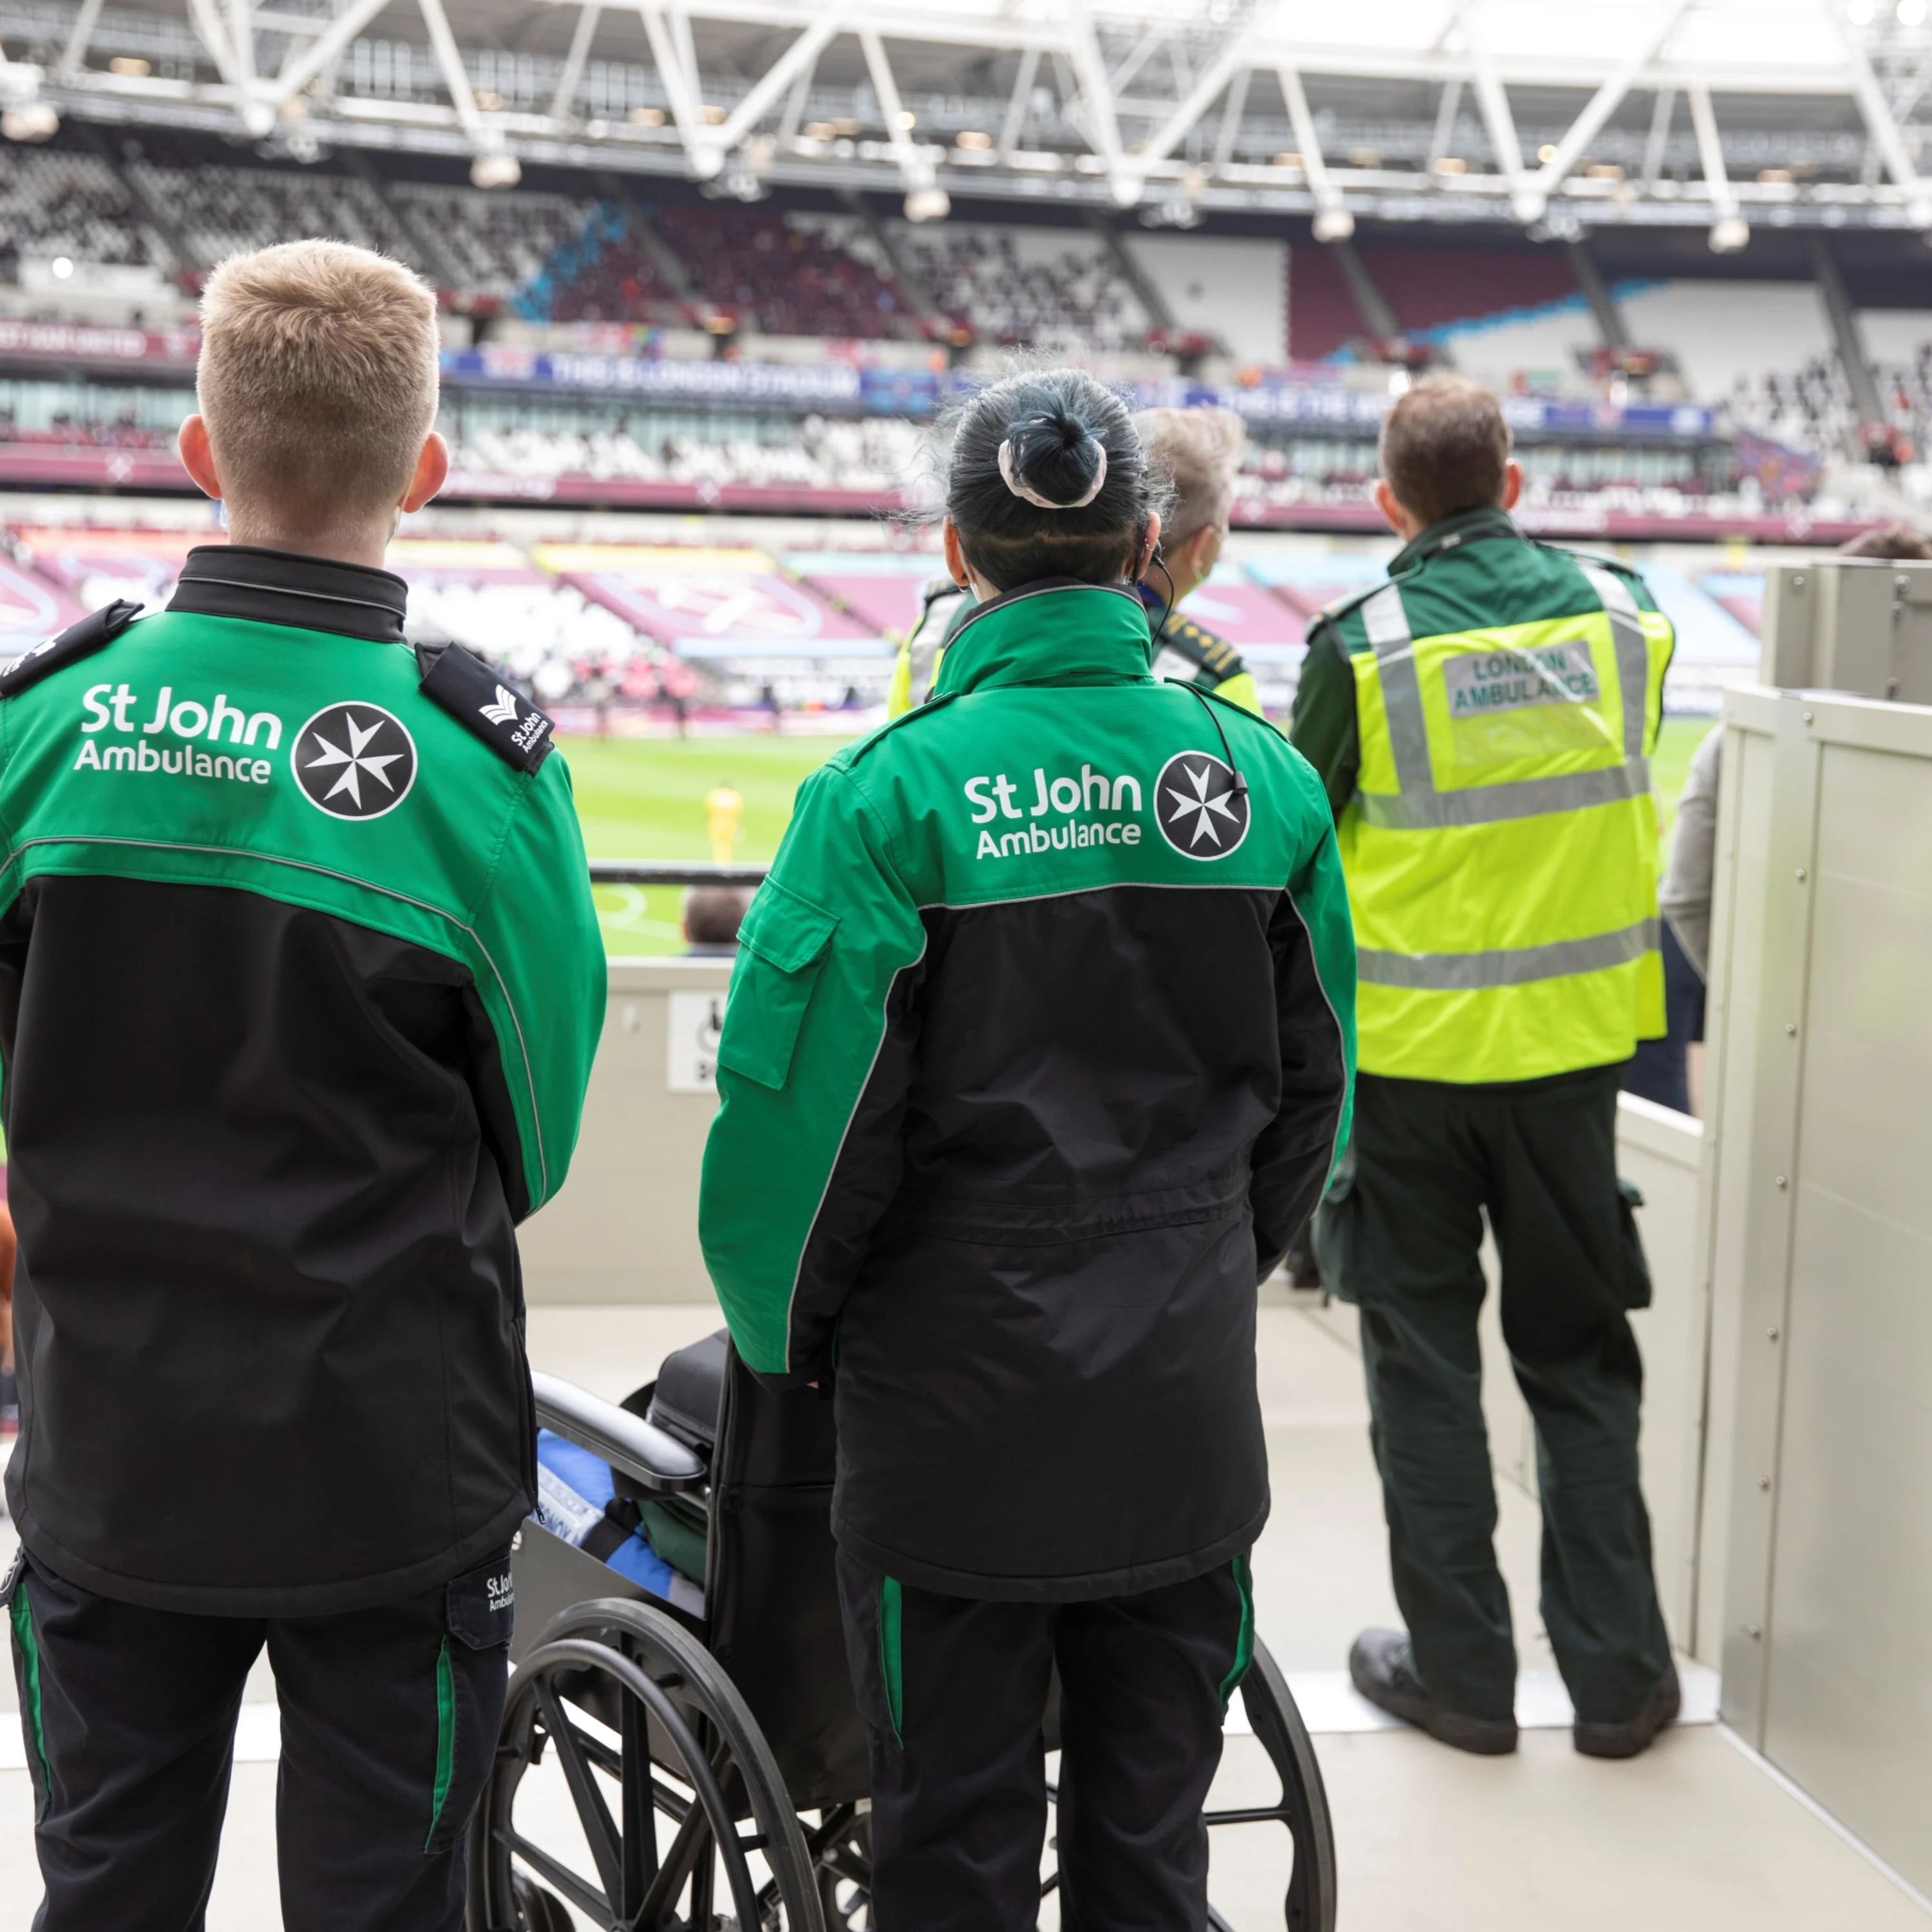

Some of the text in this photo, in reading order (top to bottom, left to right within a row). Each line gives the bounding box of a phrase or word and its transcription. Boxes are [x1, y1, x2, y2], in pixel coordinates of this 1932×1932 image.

[80, 684, 283, 750] St John
[511, 712, 542, 747] St John
[522, 720, 549, 753] Ambulance
[73, 739, 271, 784] Ambulance
[965, 764, 1142, 823] St John
[976, 820, 1142, 859] Ambulance
[486, 1571, 513, 1598] St Joh
[489, 1592, 515, 1612] Ambula
